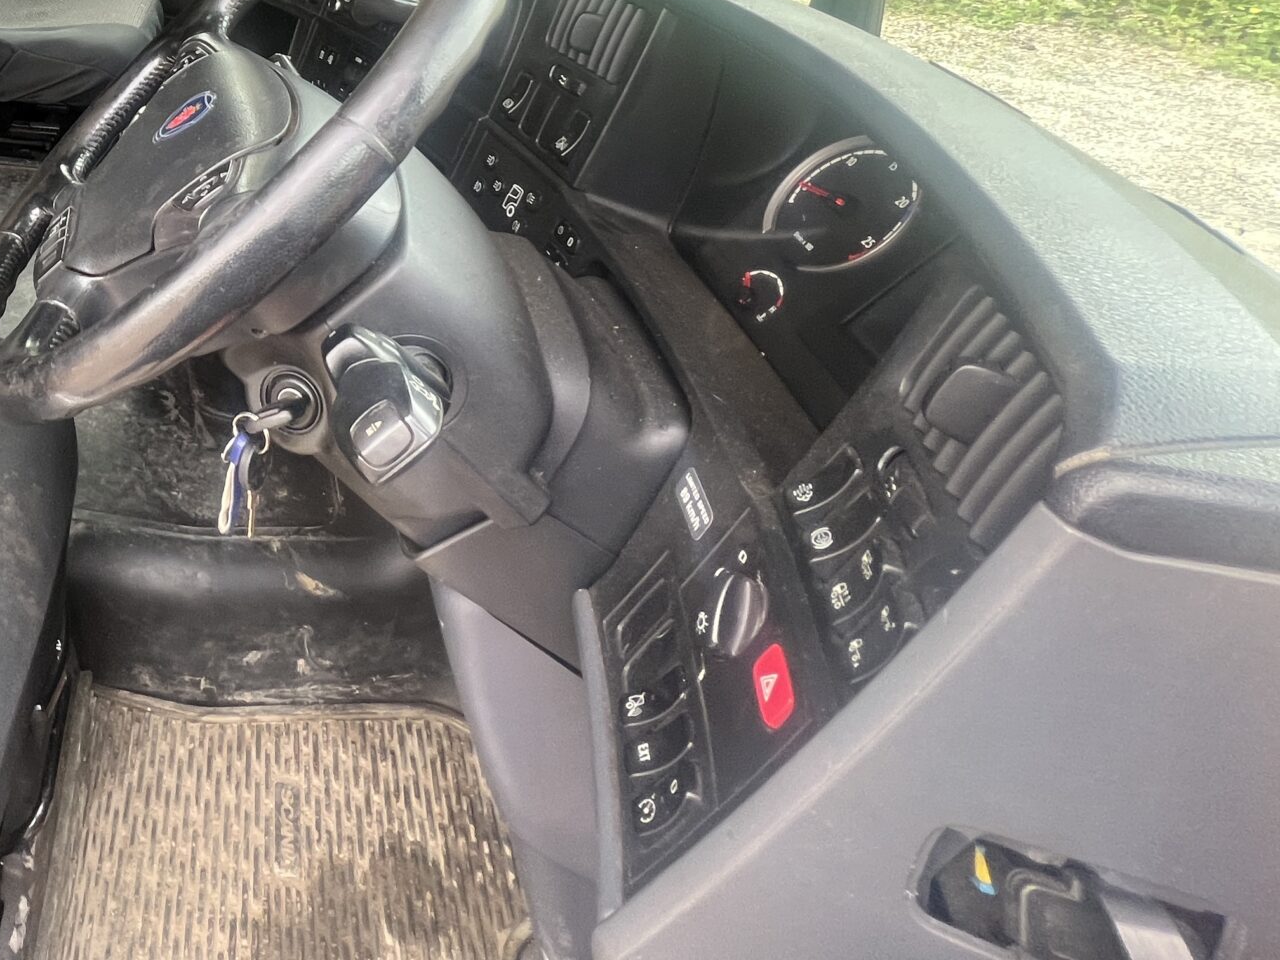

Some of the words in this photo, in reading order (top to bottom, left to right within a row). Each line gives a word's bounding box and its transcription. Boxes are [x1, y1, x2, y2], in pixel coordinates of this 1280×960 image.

[894, 195, 910, 209] 20
[860, 235, 877, 249] 25
[685, 472, 701, 501] LIMITED
[696, 499, 710, 525] SPEED
[685, 500, 700, 532] km/h
